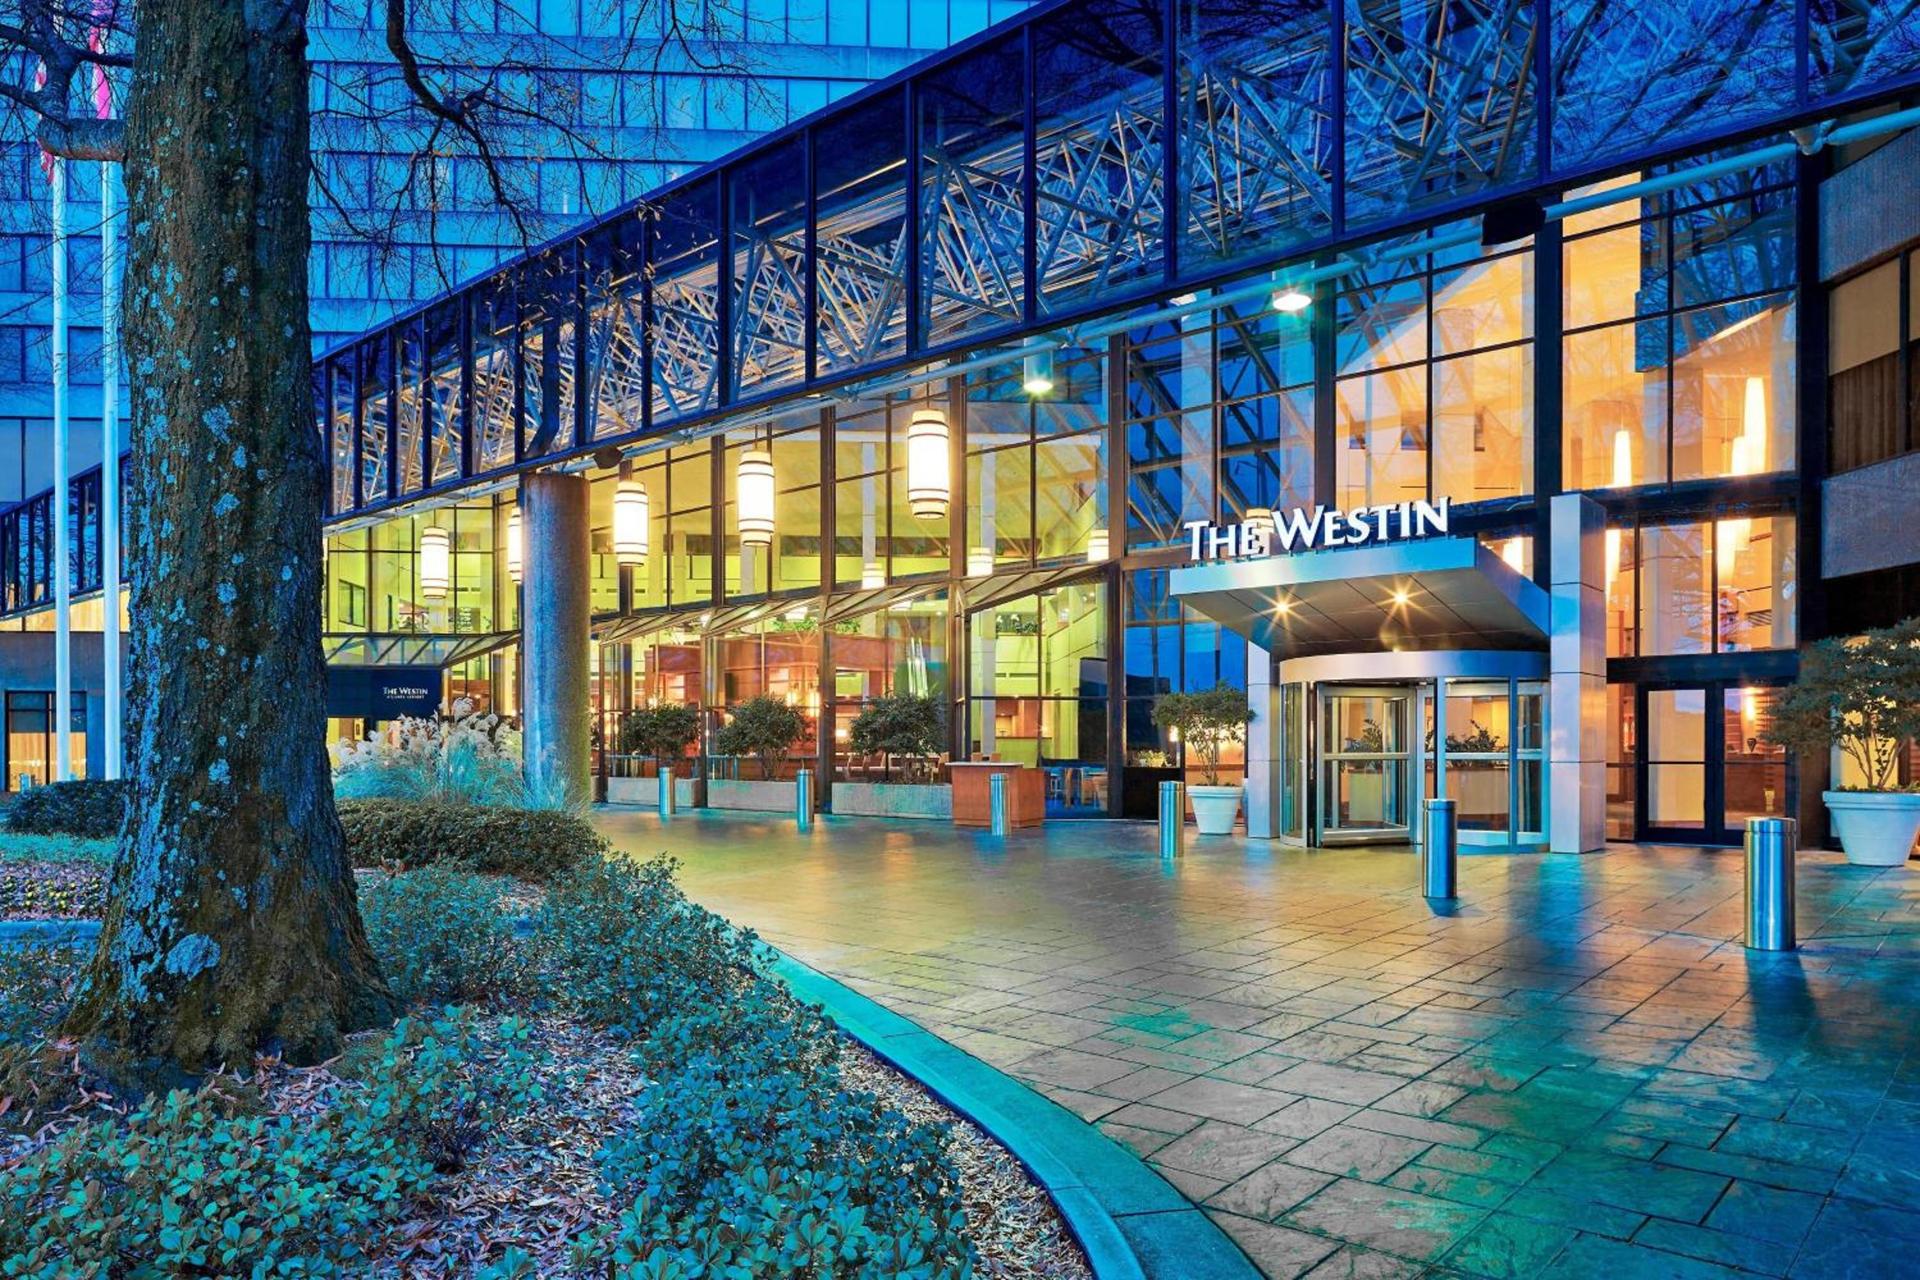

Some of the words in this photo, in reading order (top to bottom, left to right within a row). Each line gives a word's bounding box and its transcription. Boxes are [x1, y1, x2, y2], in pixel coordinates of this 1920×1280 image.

[1184, 519, 1263, 560] THE
[1271, 496, 1451, 551] WESTIN
[382, 686, 397, 695] THE
[399, 686, 428, 695] WESTIN
